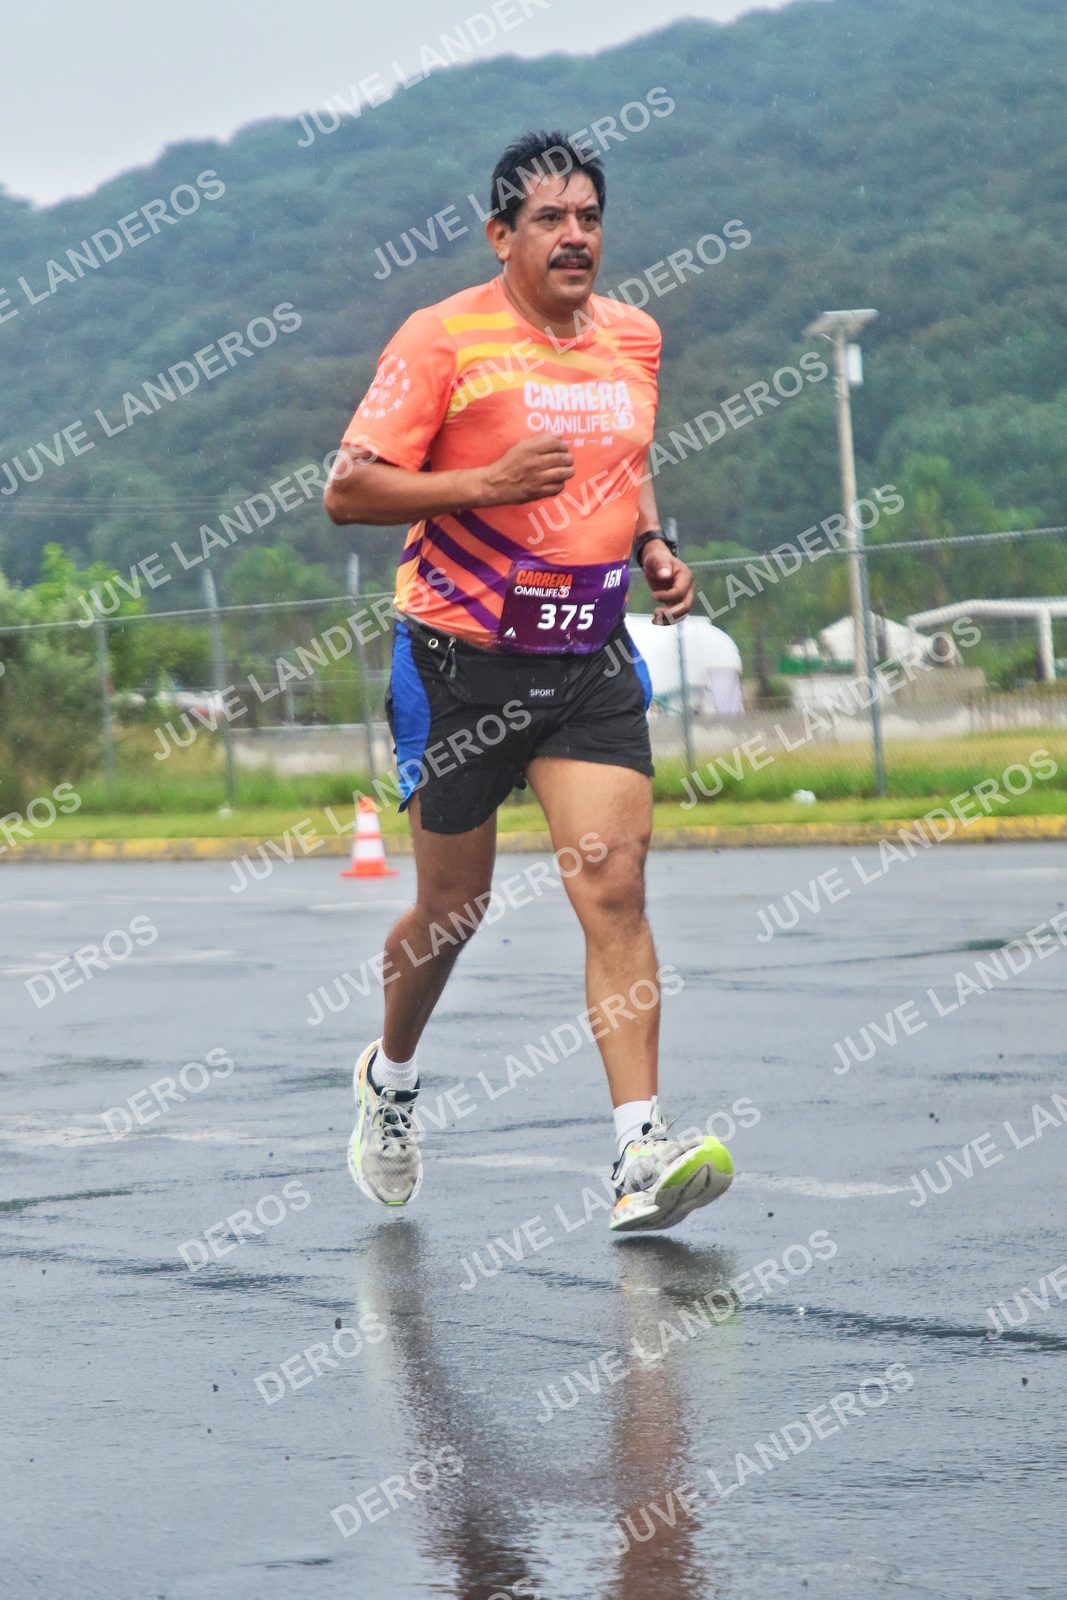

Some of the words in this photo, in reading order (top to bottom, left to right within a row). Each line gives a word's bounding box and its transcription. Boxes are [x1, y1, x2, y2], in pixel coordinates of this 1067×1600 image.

[524, 380, 631, 411] CARRERA
[516, 569, 573, 587] CARRERA
[537, 603, 596, 630] 375
[530, 688, 555, 697] SPORT
